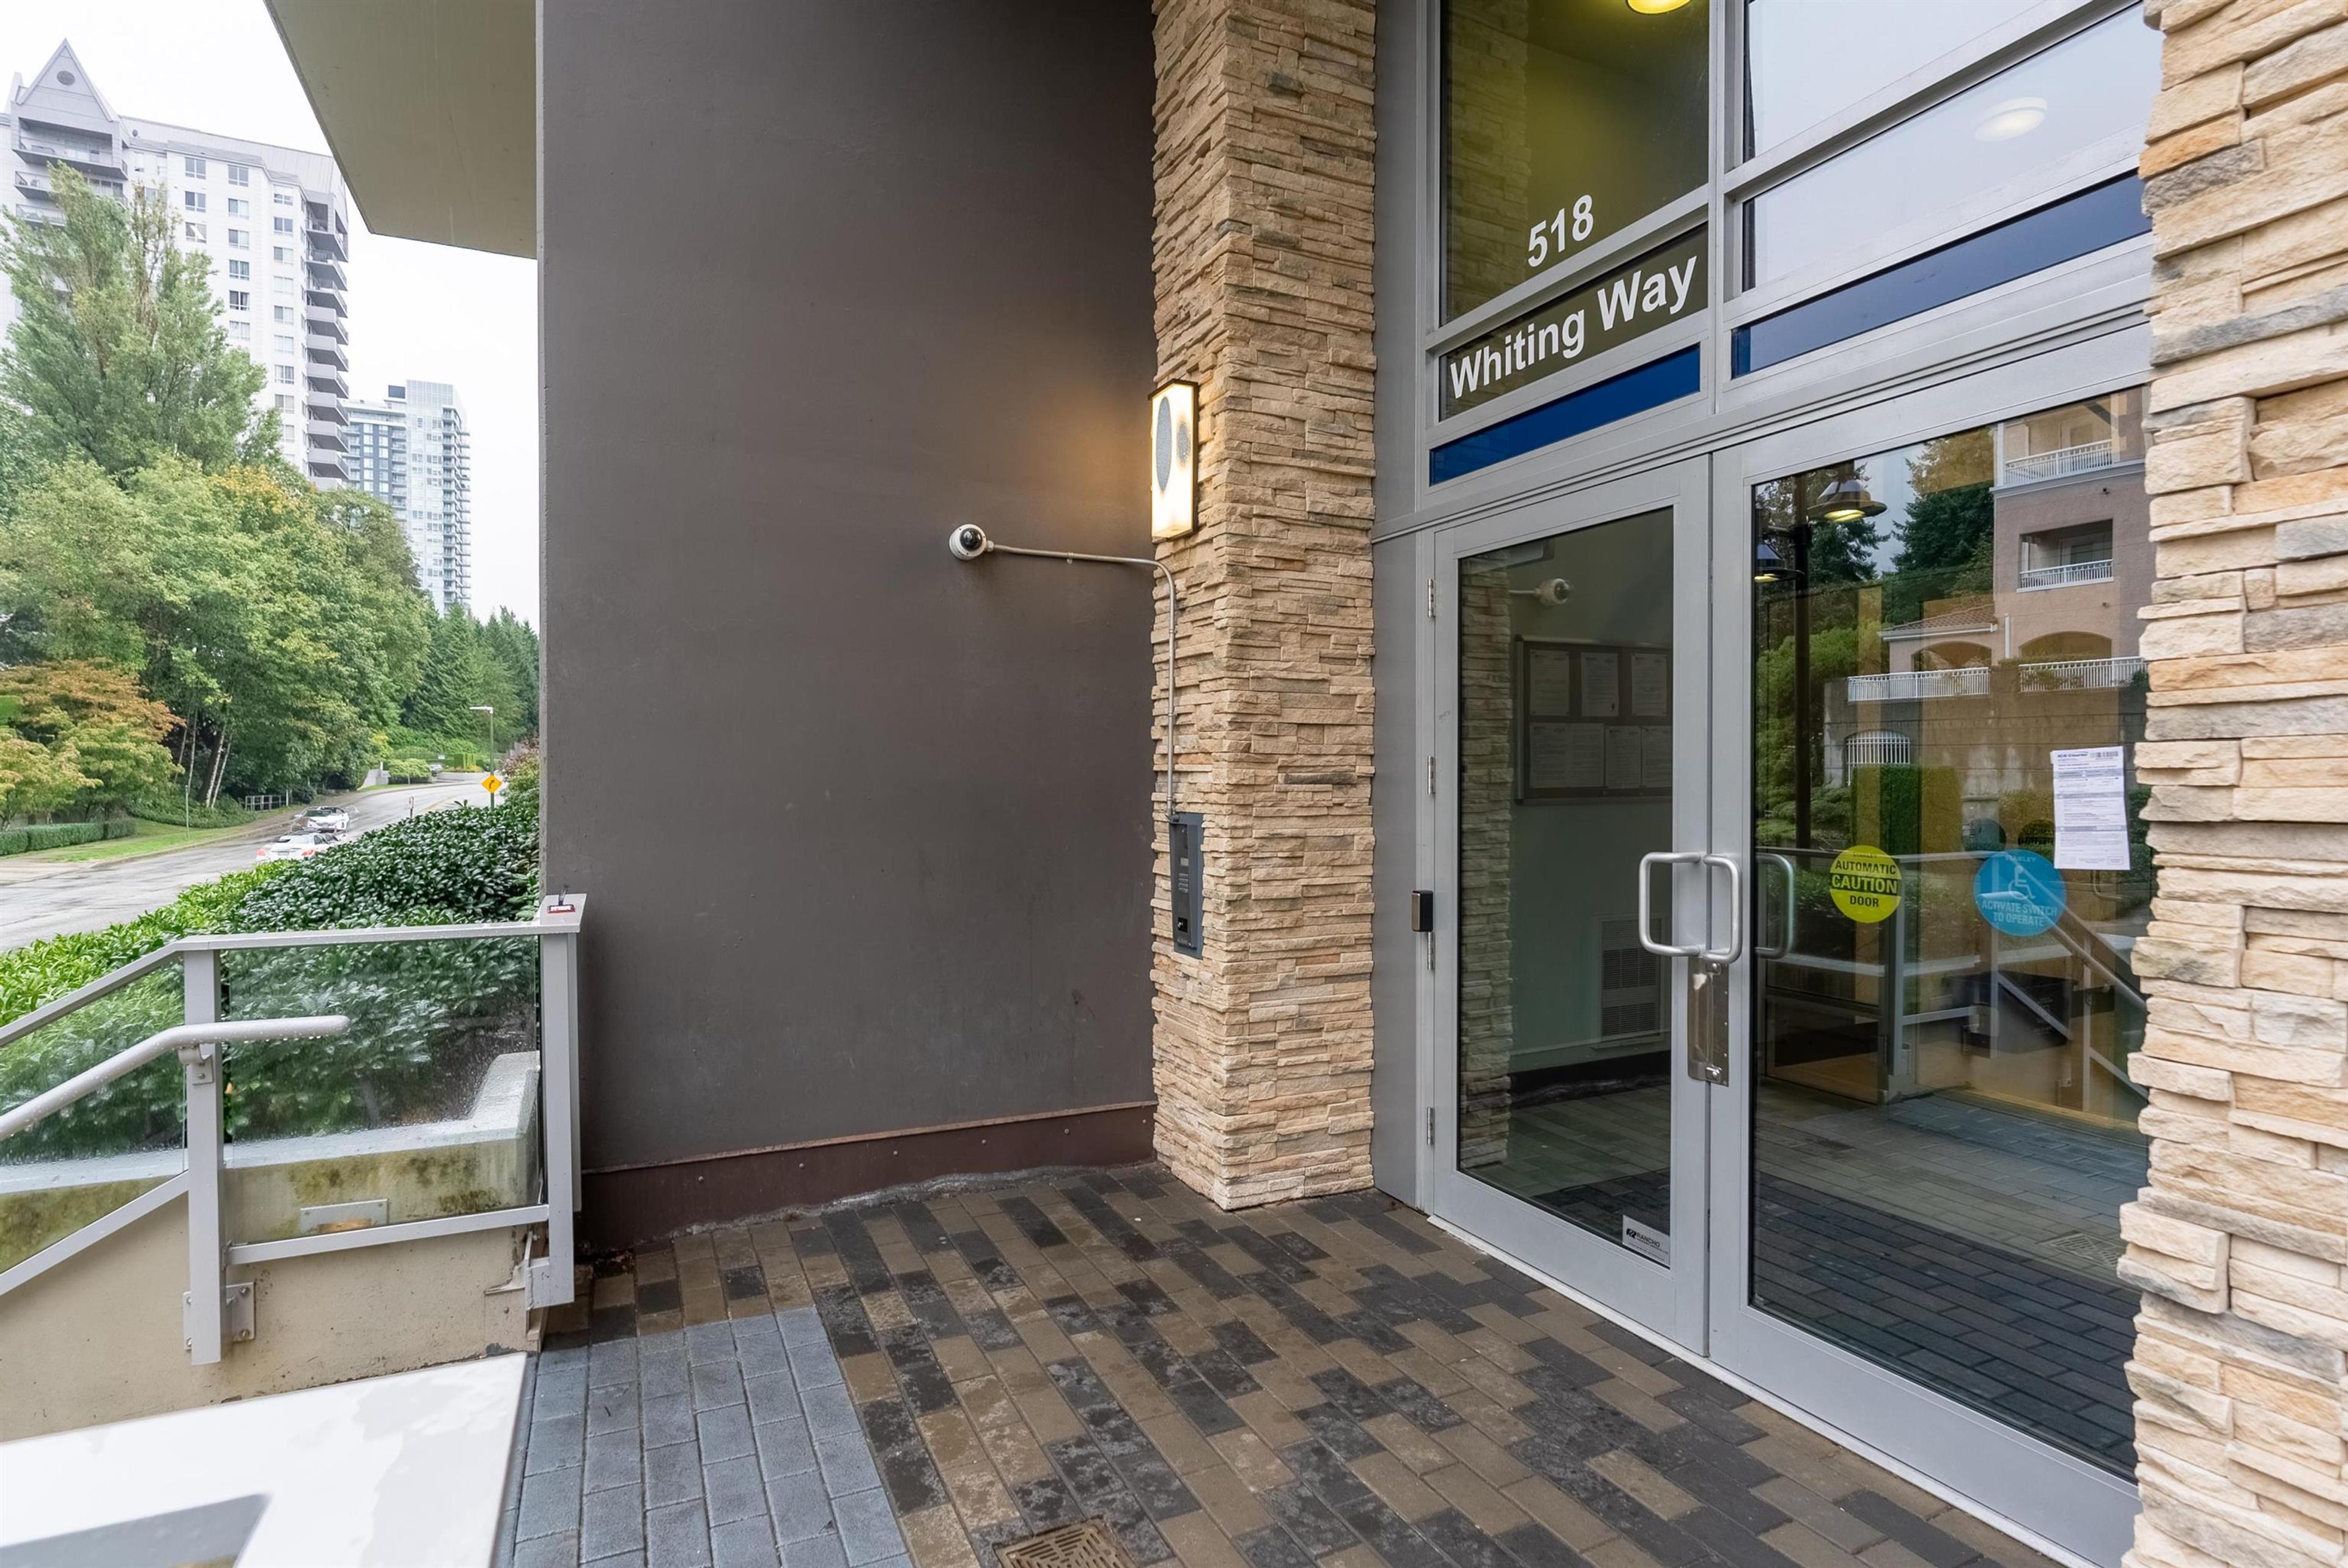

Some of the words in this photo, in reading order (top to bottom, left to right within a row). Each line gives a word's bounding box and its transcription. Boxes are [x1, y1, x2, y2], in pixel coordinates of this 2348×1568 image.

[1527, 194, 1594, 268] 518
[1450, 309, 1585, 399] Whiting
[1597, 255, 1697, 331] Way
[1835, 860, 1896, 875] AUTOMATIC
[1831, 875, 1897, 894] CAUTION
[1850, 895, 1879, 908] DOOR
[1981, 900, 2021, 913] ACTIVATE
[2023, 903, 2058, 916] SWITCH
[1994, 911, 2004, 922] TO
[2005, 913, 2045, 927] OPERATE
